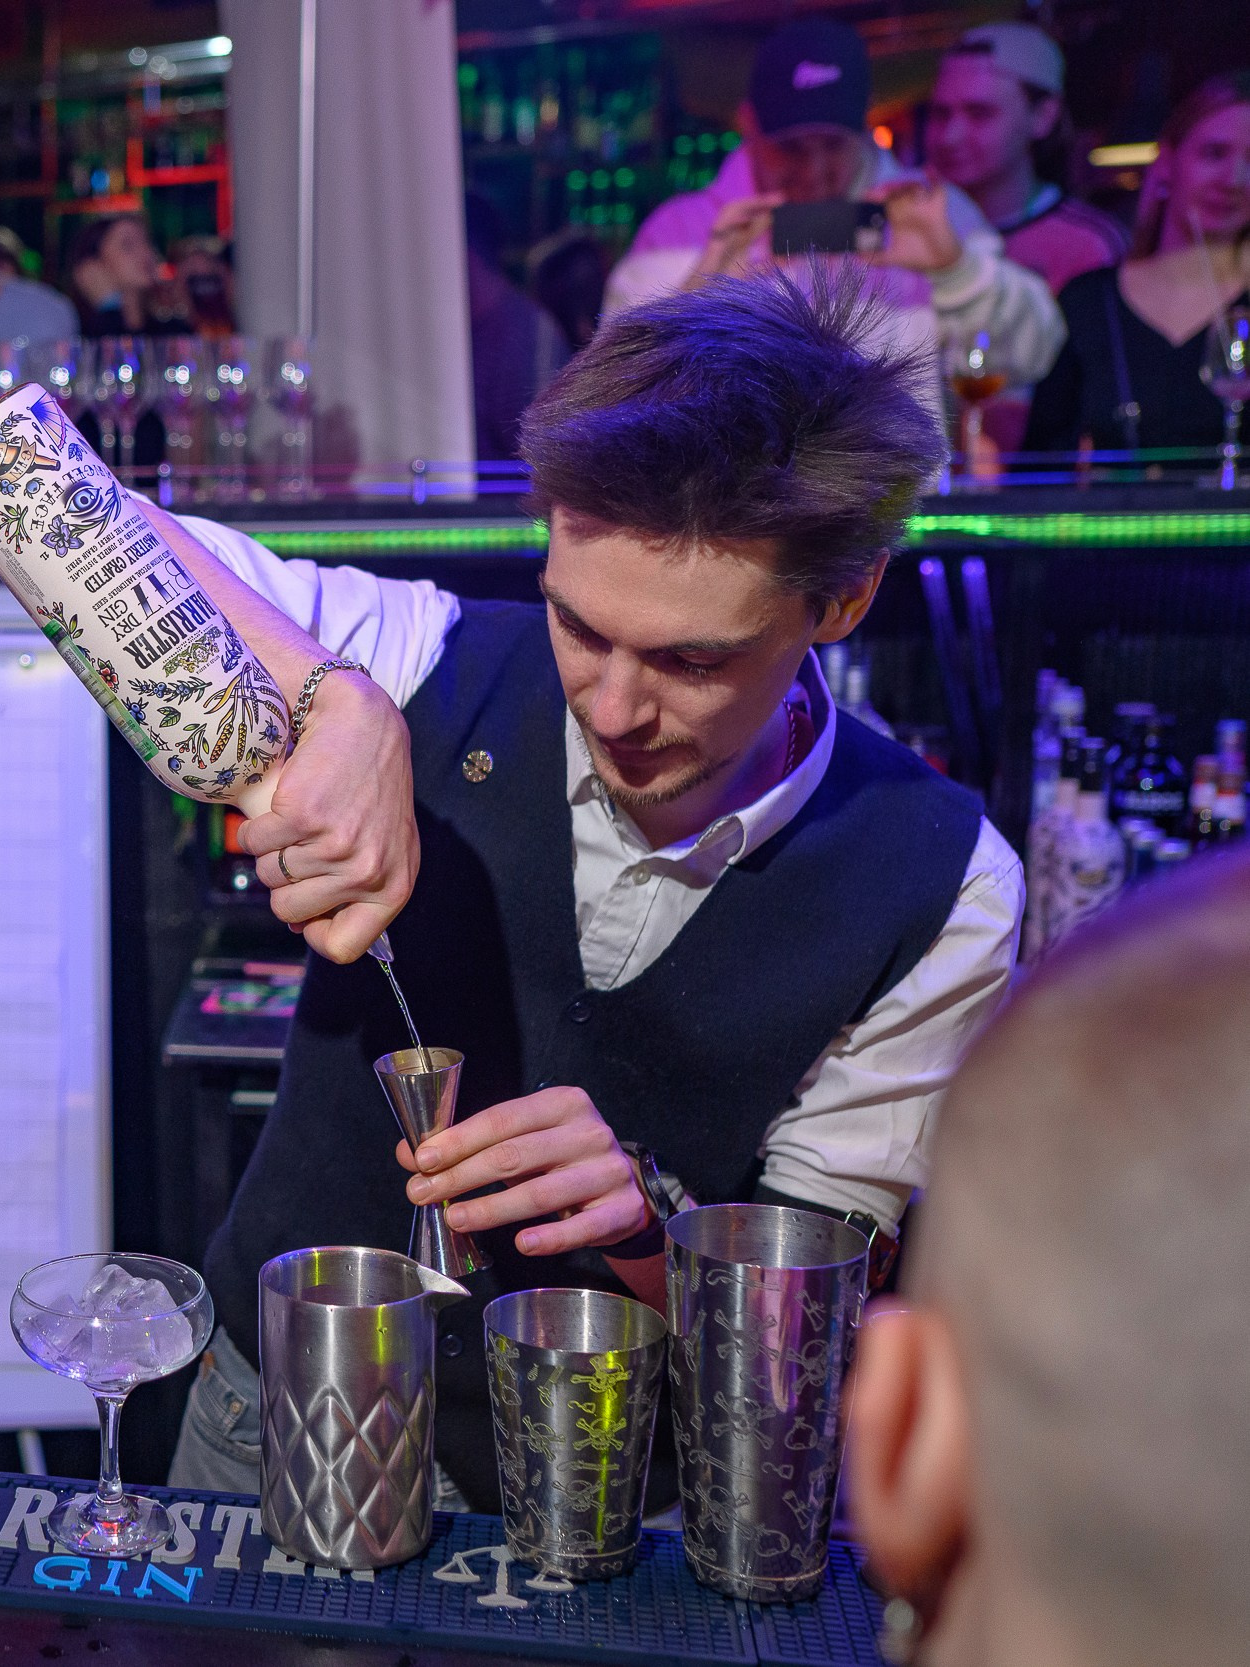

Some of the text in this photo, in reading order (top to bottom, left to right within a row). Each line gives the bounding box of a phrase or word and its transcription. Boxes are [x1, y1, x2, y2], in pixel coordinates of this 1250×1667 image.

[7, 449, 33, 480] GIN
[29, 480, 64, 532] FACE
[97, 531, 115, 548] FINEST
[113, 525, 124, 535] THE
[116, 537, 125, 545] OF
[80, 544, 98, 560] GRAIN
[96, 542, 118, 560] JUNIPER
[120, 529, 160, 566] MASTERLY
[64, 556, 83, 573] SPIRIT
[82, 553, 128, 595] CRAFTED
[134, 563, 152, 578] SPECIAL
[91, 596, 108, 611] SERIES
[96, 596, 130, 627] GIN
[108, 558, 194, 642] B47 DRY
[123, 590, 217, 670] BARRISTER
[33, 1555, 204, 1602] GIN
